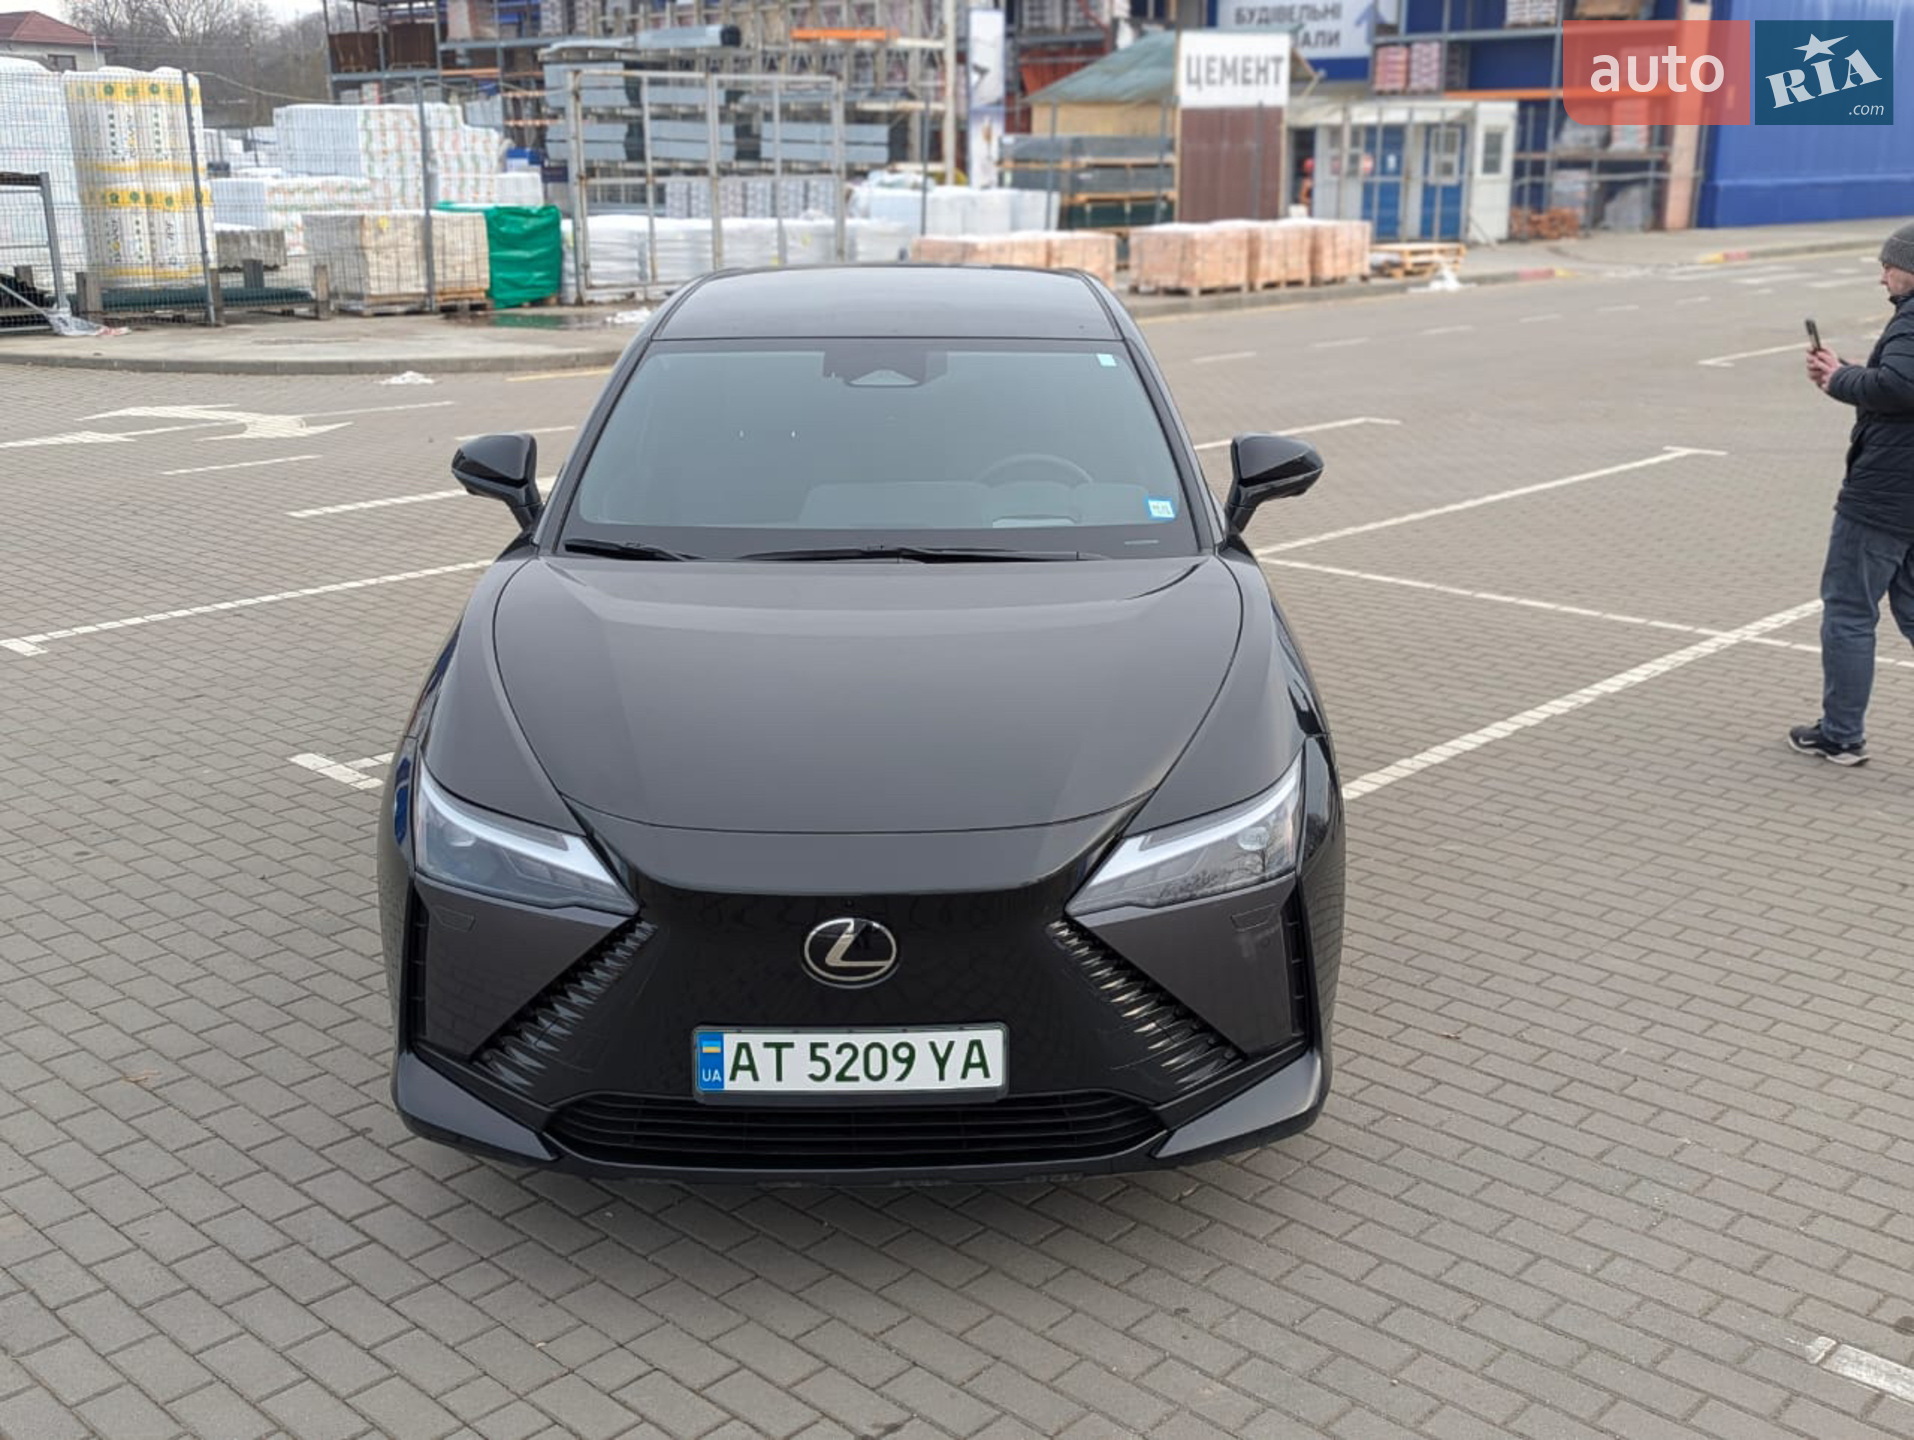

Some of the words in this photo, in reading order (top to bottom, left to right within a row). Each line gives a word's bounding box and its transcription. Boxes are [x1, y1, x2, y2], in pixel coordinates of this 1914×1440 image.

[1234, 3, 1342, 25] БУДІВЕЛЬНІ
[1186, 54, 1284, 91] ЦЕМЕНТ
[729, 1041, 795, 1082] AT
[807, 1041, 916, 1082] 5209
[928, 1039, 991, 1082] YA
[702, 1068, 722, 1083] UA
